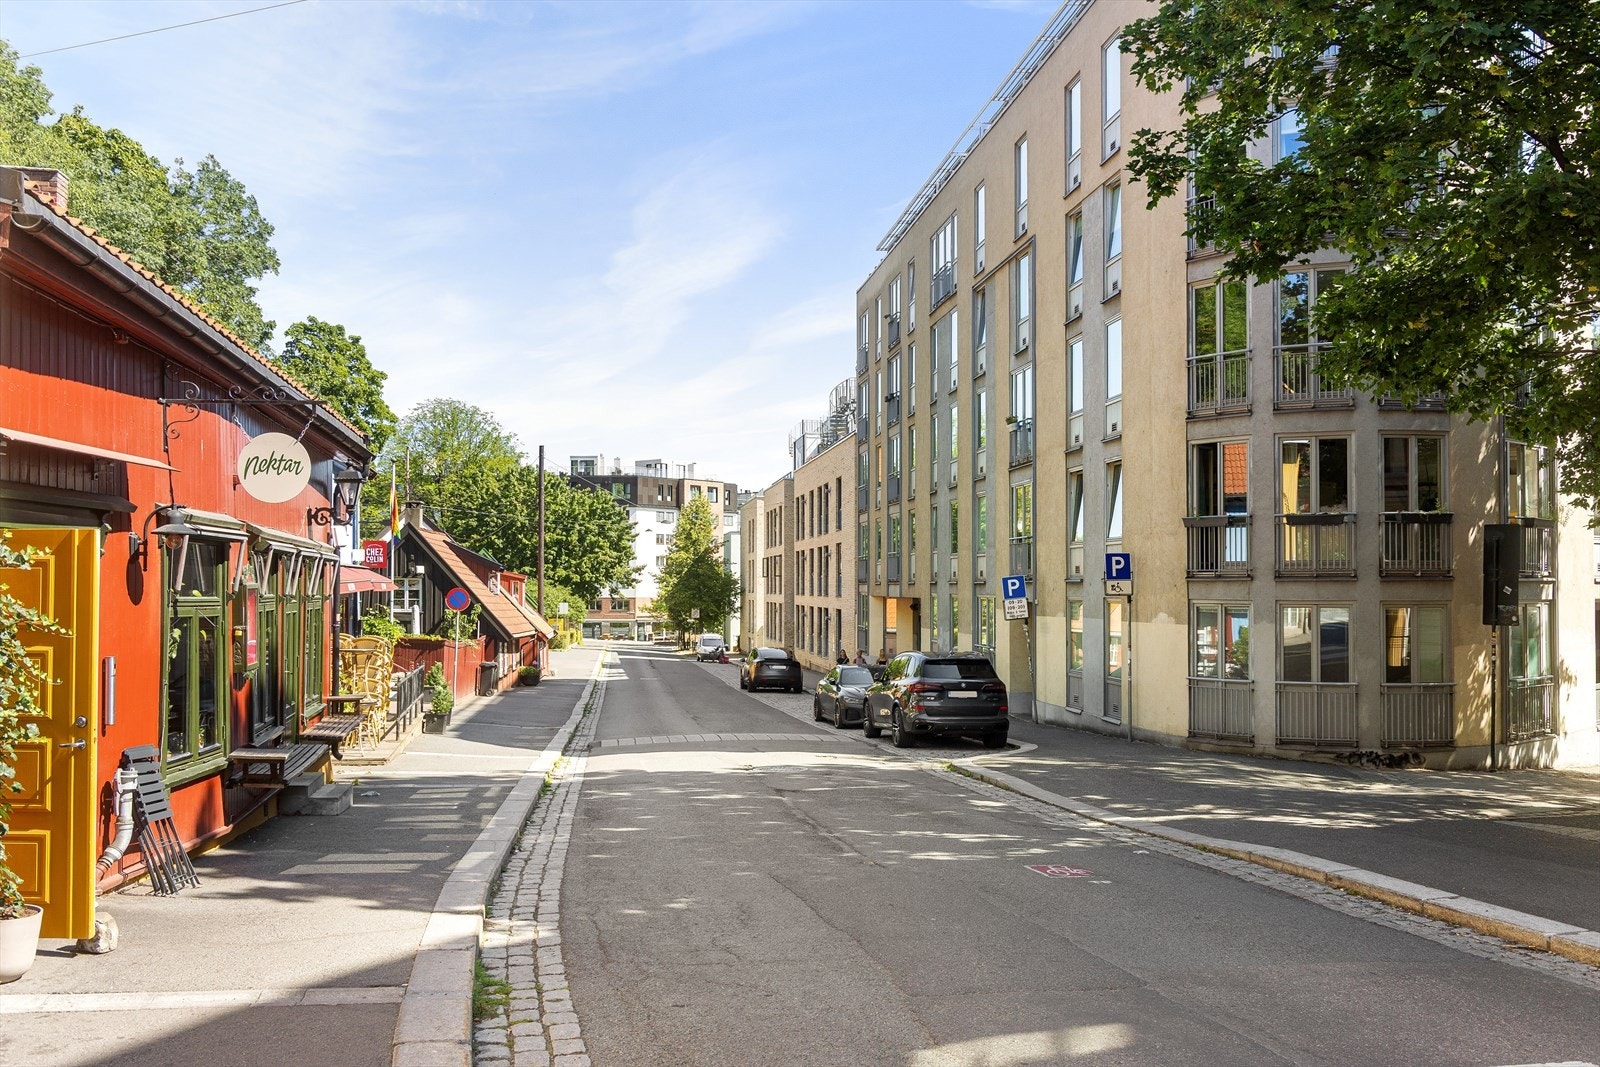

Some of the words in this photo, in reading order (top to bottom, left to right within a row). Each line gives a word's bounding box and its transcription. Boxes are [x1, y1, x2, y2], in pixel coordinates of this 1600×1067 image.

[366, 548, 384, 556] CHEZ
[1111, 556, 1125, 577] P
[1007, 579, 1020, 597] P
